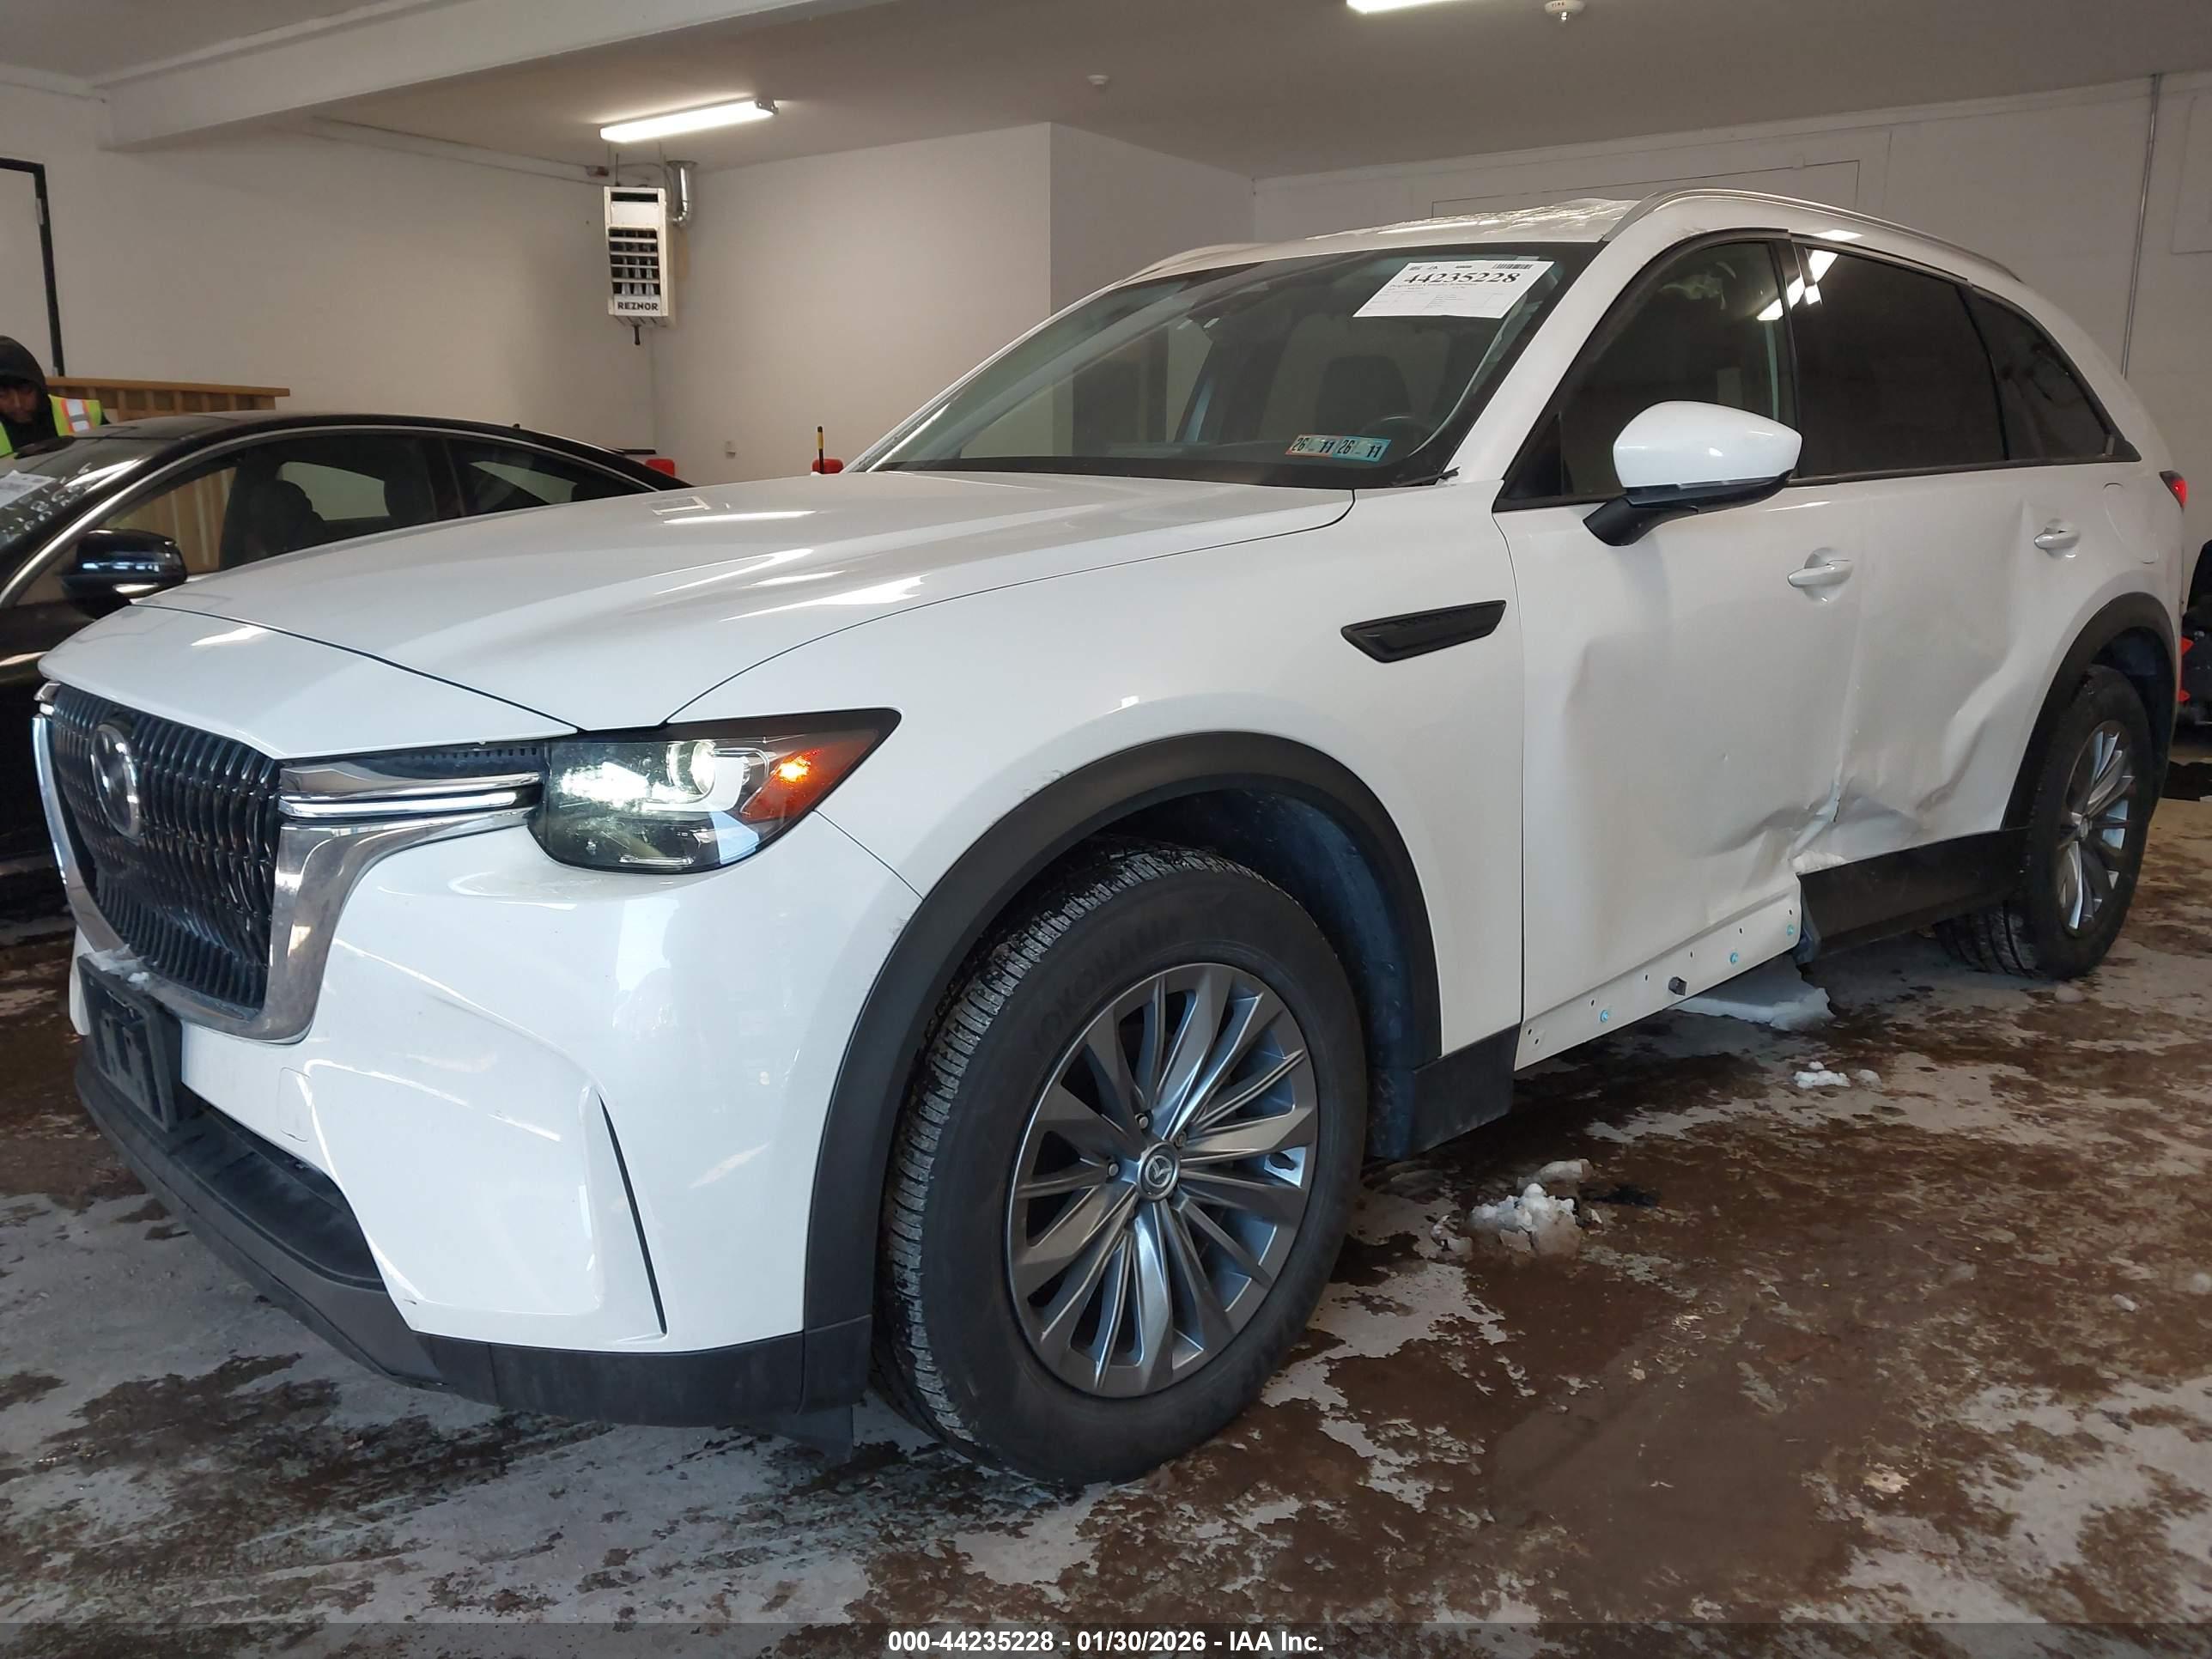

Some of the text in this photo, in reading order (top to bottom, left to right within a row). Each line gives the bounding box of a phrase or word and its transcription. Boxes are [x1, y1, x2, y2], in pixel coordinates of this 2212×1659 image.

[1404, 272, 1521, 283] 44235228
[617, 301, 659, 310] REZNOR
[1291, 437, 1335, 453] 26 11
[1337, 439, 1382, 458] 26 11
